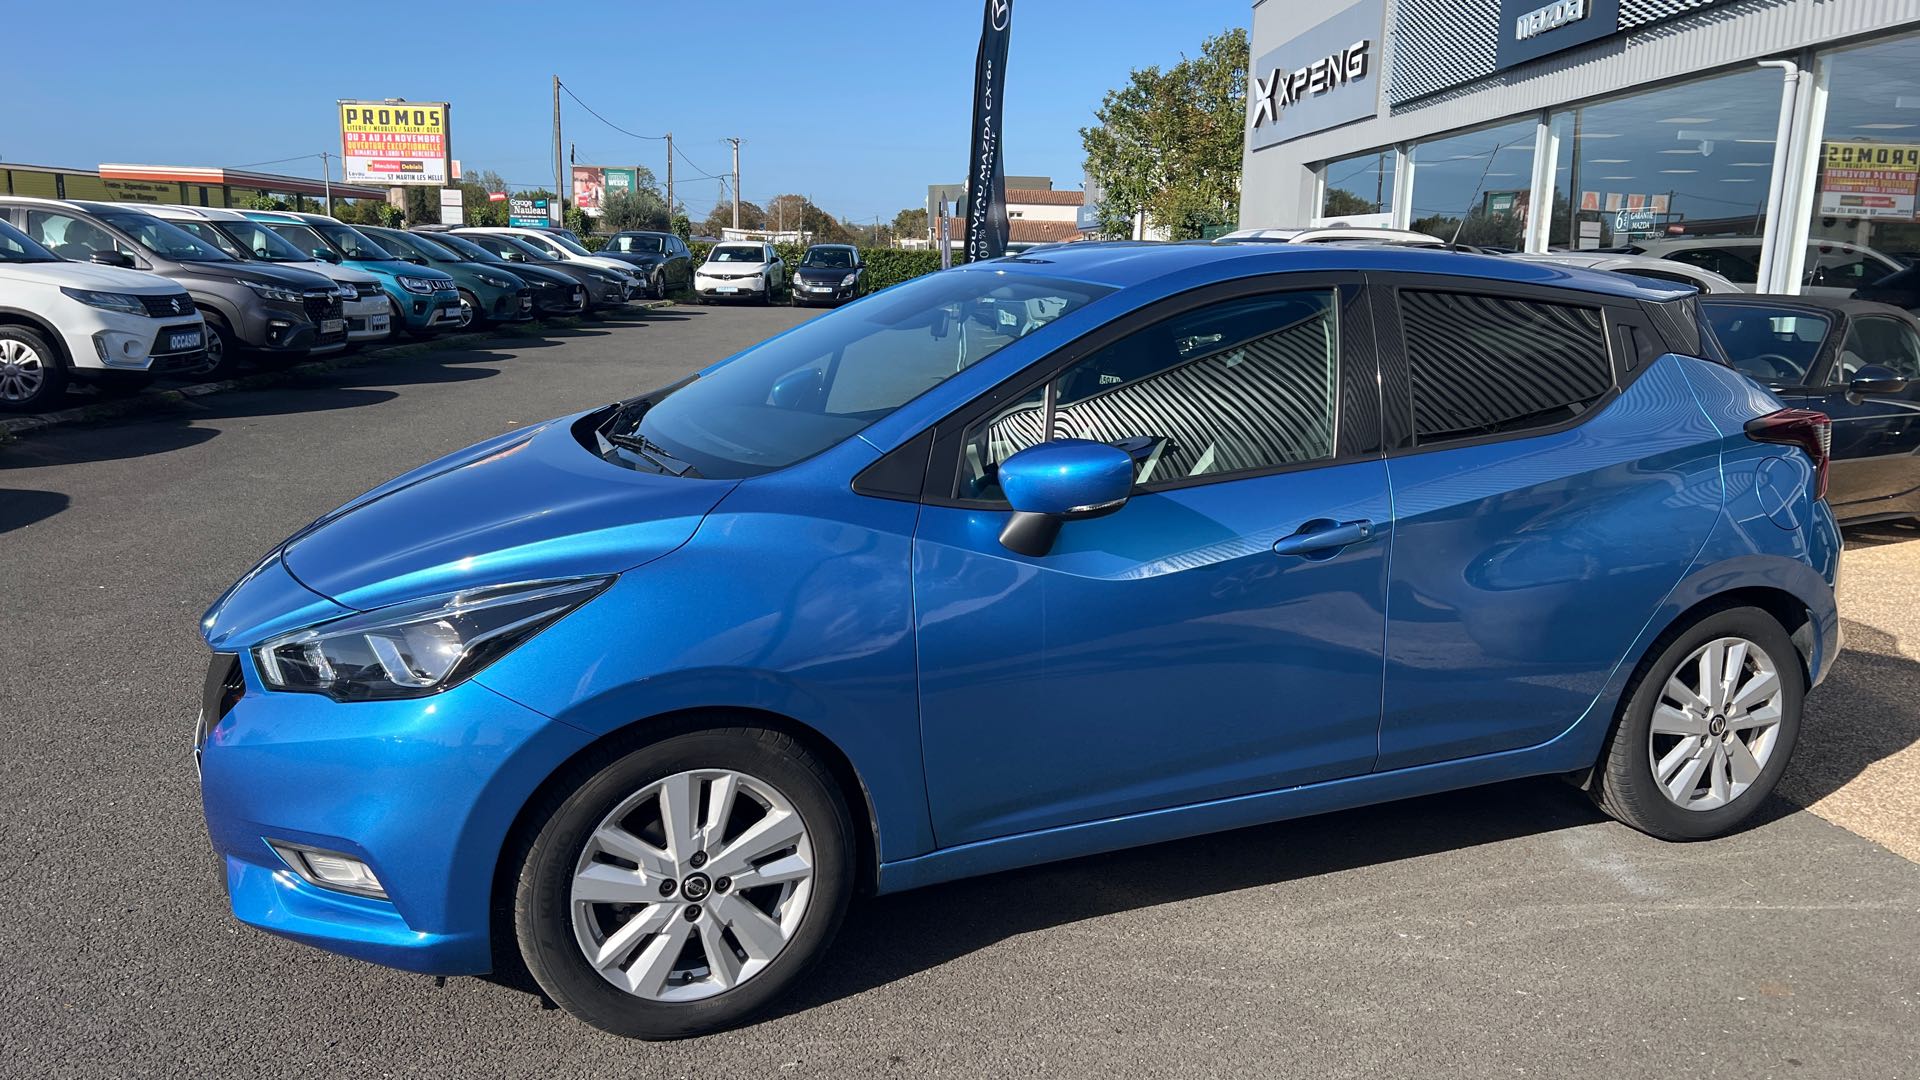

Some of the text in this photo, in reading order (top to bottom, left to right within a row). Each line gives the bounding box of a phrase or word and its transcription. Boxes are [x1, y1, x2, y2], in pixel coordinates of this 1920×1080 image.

[1279, 40, 1370, 106] XPENG
[346, 109, 440, 126] PROMOS
[347, 133, 359, 141] DU
[368, 134, 379, 142] AU
[382, 134, 392, 142] 14
[394, 134, 441, 143] NOVEMBRE
[348, 141, 441, 151] OUVERTURE EXCEPTIONNELLE
[980, 116, 991, 180] MAZDA
[510, 199, 532, 207] Garage
[514, 206, 547, 215] Nauleau
[1630, 211, 1654, 220] GARANTIE
[1616, 210, 1623, 229] 6
[1631, 221, 1650, 229] MAZDA
